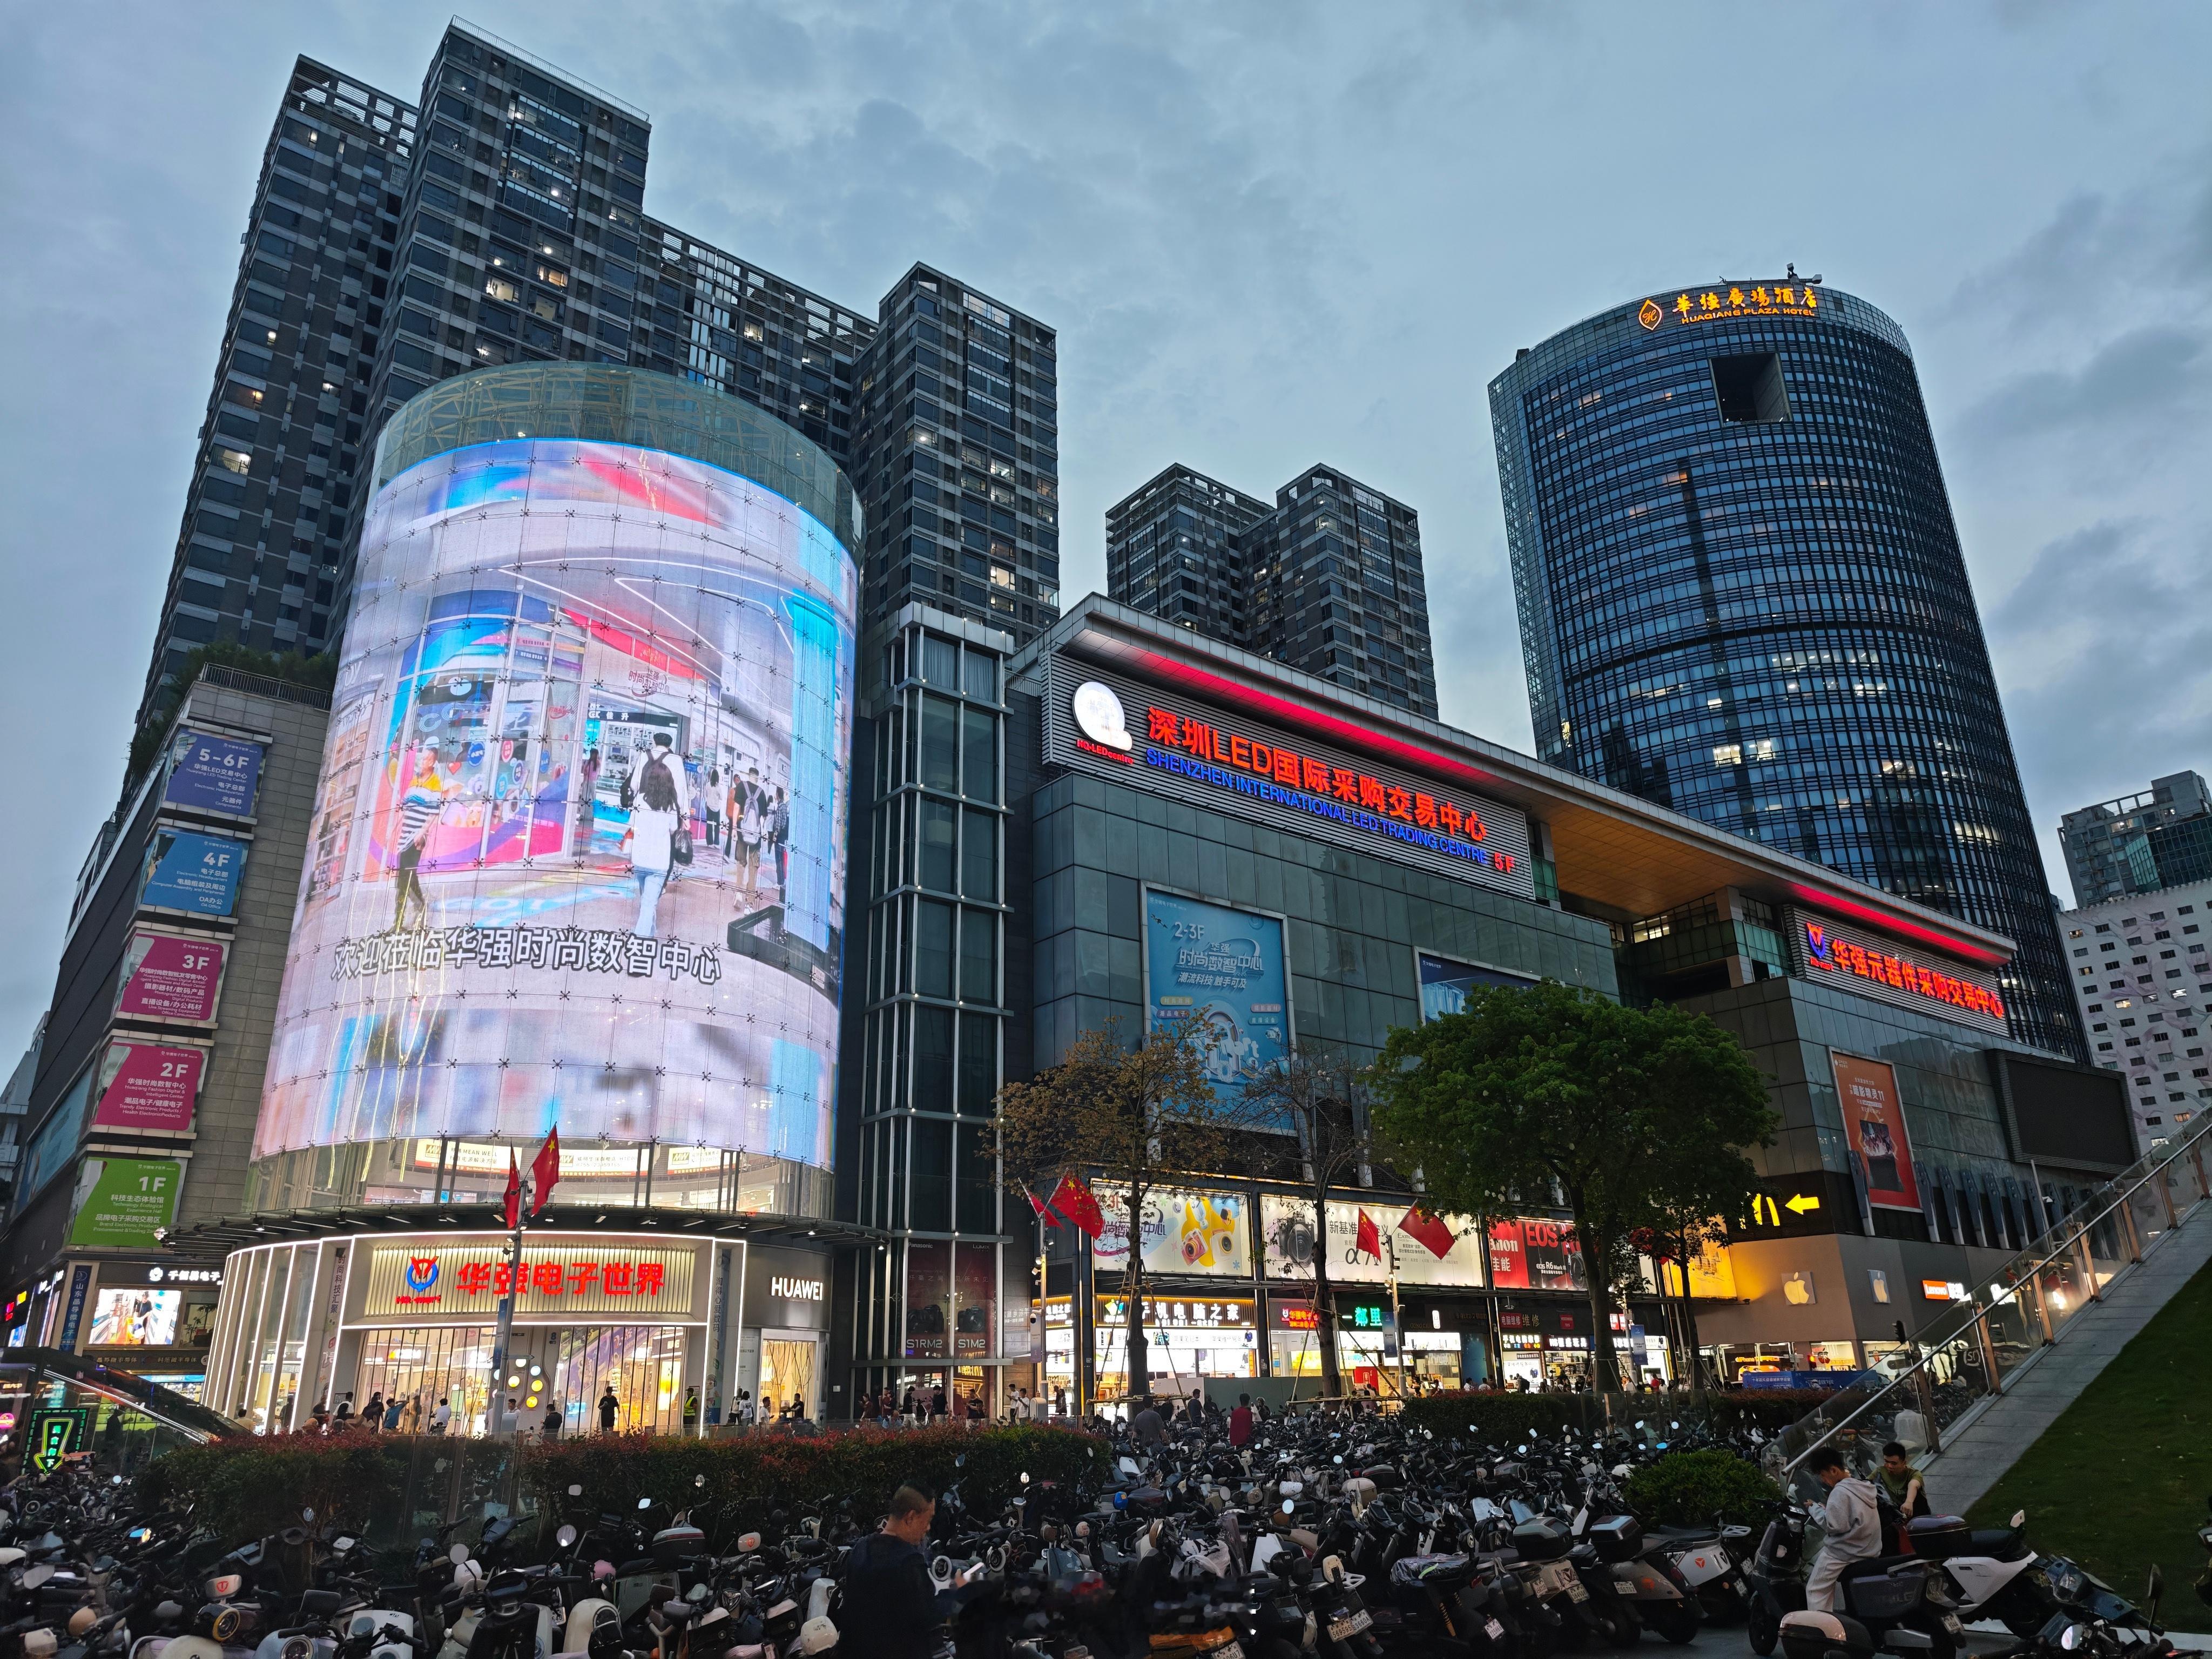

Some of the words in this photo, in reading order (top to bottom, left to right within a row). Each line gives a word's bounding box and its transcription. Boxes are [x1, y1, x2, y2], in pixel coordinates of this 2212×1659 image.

[1681, 309, 1741, 325] HUAQIANG
[1744, 307, 1780, 316] PLAZA
[1783, 308, 1815, 317] HOTEL
[194, 763, 247, 779] 华强LED交易中心
[1147, 706, 1487, 841] 深圳LED国际采购交易中心
[218, 781, 246, 792] 电子总部
[222, 796, 242, 805] 元器件
[1146, 747, 1233, 788] SHENZHEN
[1236, 775, 1351, 825] INTERNATIONAL
[1352, 811, 1379, 832] LED
[1380, 820, 1439, 850] TRADING
[1439, 837, 1489, 865] CENTRE
[204, 852, 230, 867] 4F
[201, 868, 229, 878] 电子总部
[177, 878, 226, 892] 电脑组装及周边
[199, 896, 223, 905] OA办公
[1175, 921, 1205, 940] 2-3F
[1210, 942, 1231, 953] 华强
[182, 954, 210, 970] 3F
[330, 926, 723, 986] 欢迎莅临华强时尚数智中心
[1179, 946, 1265, 973] 时尚数智中心
[1178, 972, 1214, 986] 潮流科技
[1213, 975, 1247, 989] 触手可及
[1831, 939, 2004, 1019] 华强元器件采购交易中心
[141, 997, 202, 1010] 直播设备/办公耗材
[160, 1062, 188, 1078] 2F
[127, 1077, 186, 1089] 华强时尚数智中心
[124, 1097, 183, 1108] 潮品电子/健康电子
[139, 1176, 166, 1192] 1F
[111, 1194, 165, 1204] 科技生态体验馆
[95, 1213, 161, 1224] 品牌电子采购交易区
[1525, 1222, 1559, 1248] EOS
[1546, 1262, 1554, 1270] R6
[330, 1253, 347, 1314] 时尚科技汇聚
[455, 1260, 665, 1296] 华强电子世界
[771, 1276, 824, 1301] HUAWEI
[1925, 1284, 1947, 1295] Lenovo
[1522, 1314, 1540, 1327] 维修
[906, 1339, 942, 1348] S1RM2
[958, 1339, 986, 1348] S1M2
[1332, 1624, 1352, 1638] 569595
